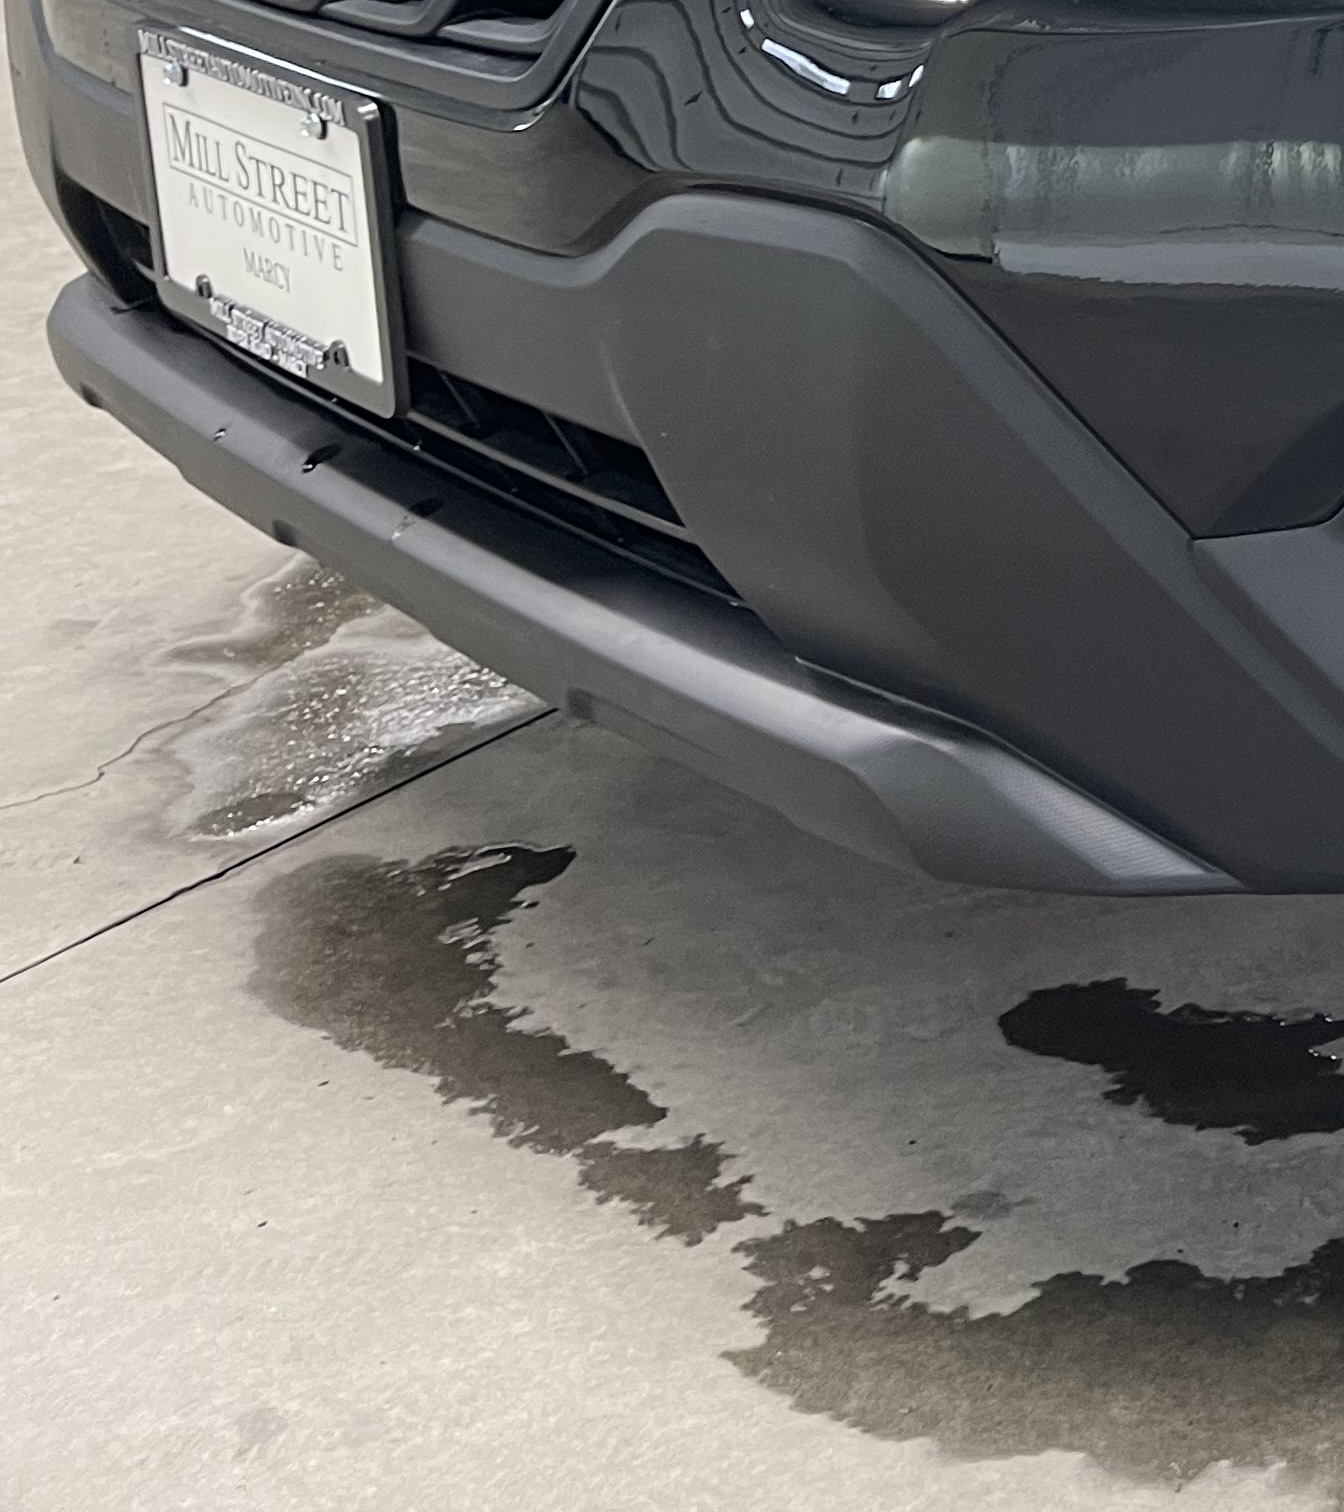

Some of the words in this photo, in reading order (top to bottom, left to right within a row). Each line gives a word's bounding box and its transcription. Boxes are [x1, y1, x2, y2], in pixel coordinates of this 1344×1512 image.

[169, 113, 229, 182] MILL
[234, 140, 349, 233] STREET
[188, 182, 344, 272] AUTOMOTIVE
[243, 247, 291, 293] MARCY
